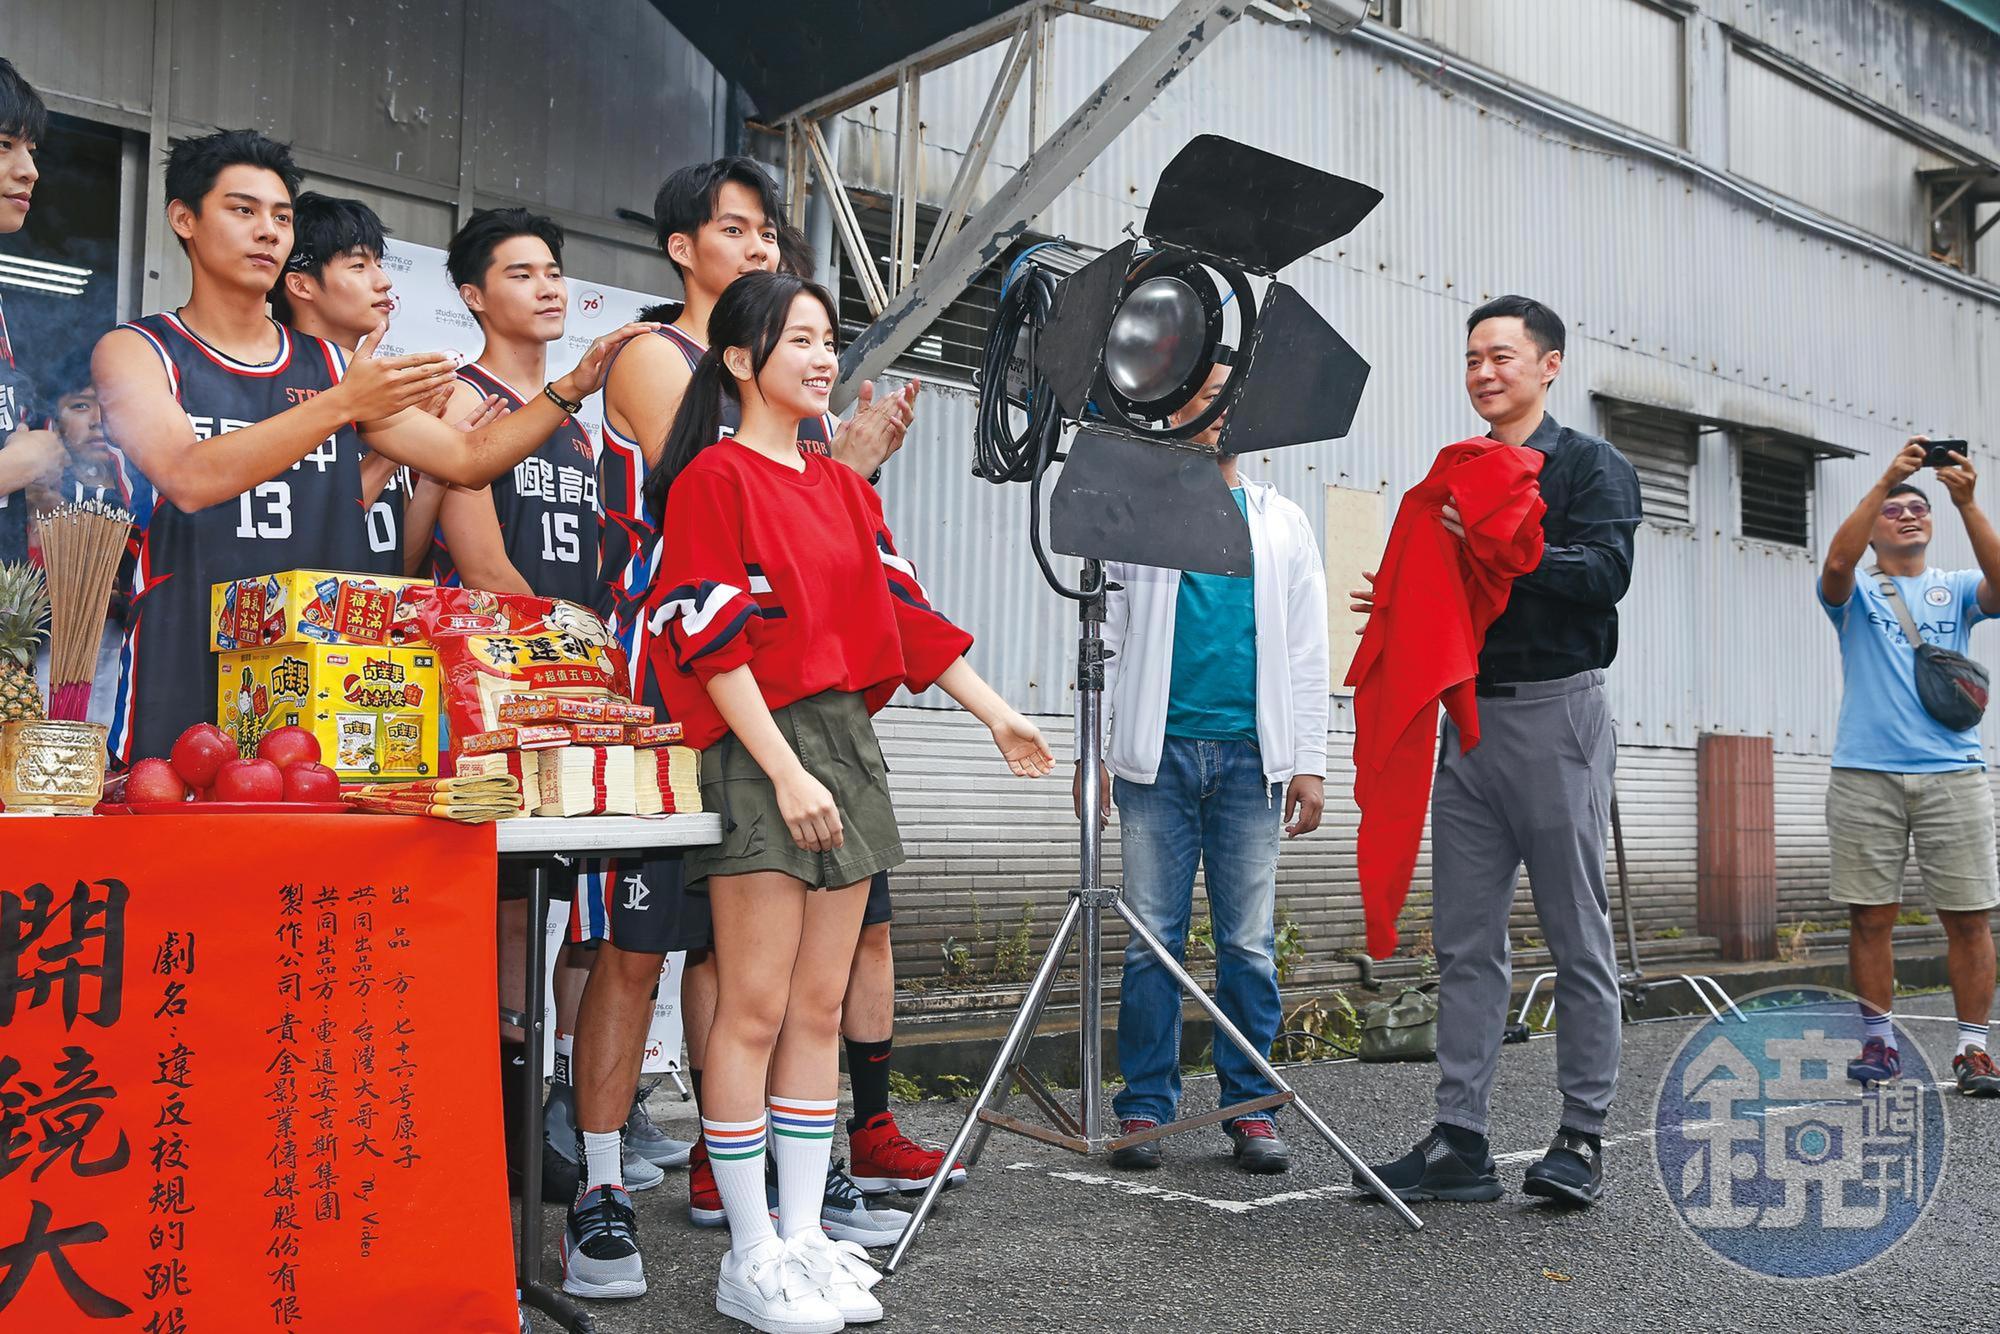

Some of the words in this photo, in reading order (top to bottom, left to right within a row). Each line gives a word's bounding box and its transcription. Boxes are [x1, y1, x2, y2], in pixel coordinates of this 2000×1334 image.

[584, 299, 598, 311] 76
[569, 335, 592, 345] studio7
[796, 440, 828, 455] STAR
[236, 481, 293, 539] 13
[365, 502, 396, 552] 0
[541, 512, 580, 563] 15
[545, 669, 606, 683] 超值五包入
[645, 1046, 659, 1060] 76
